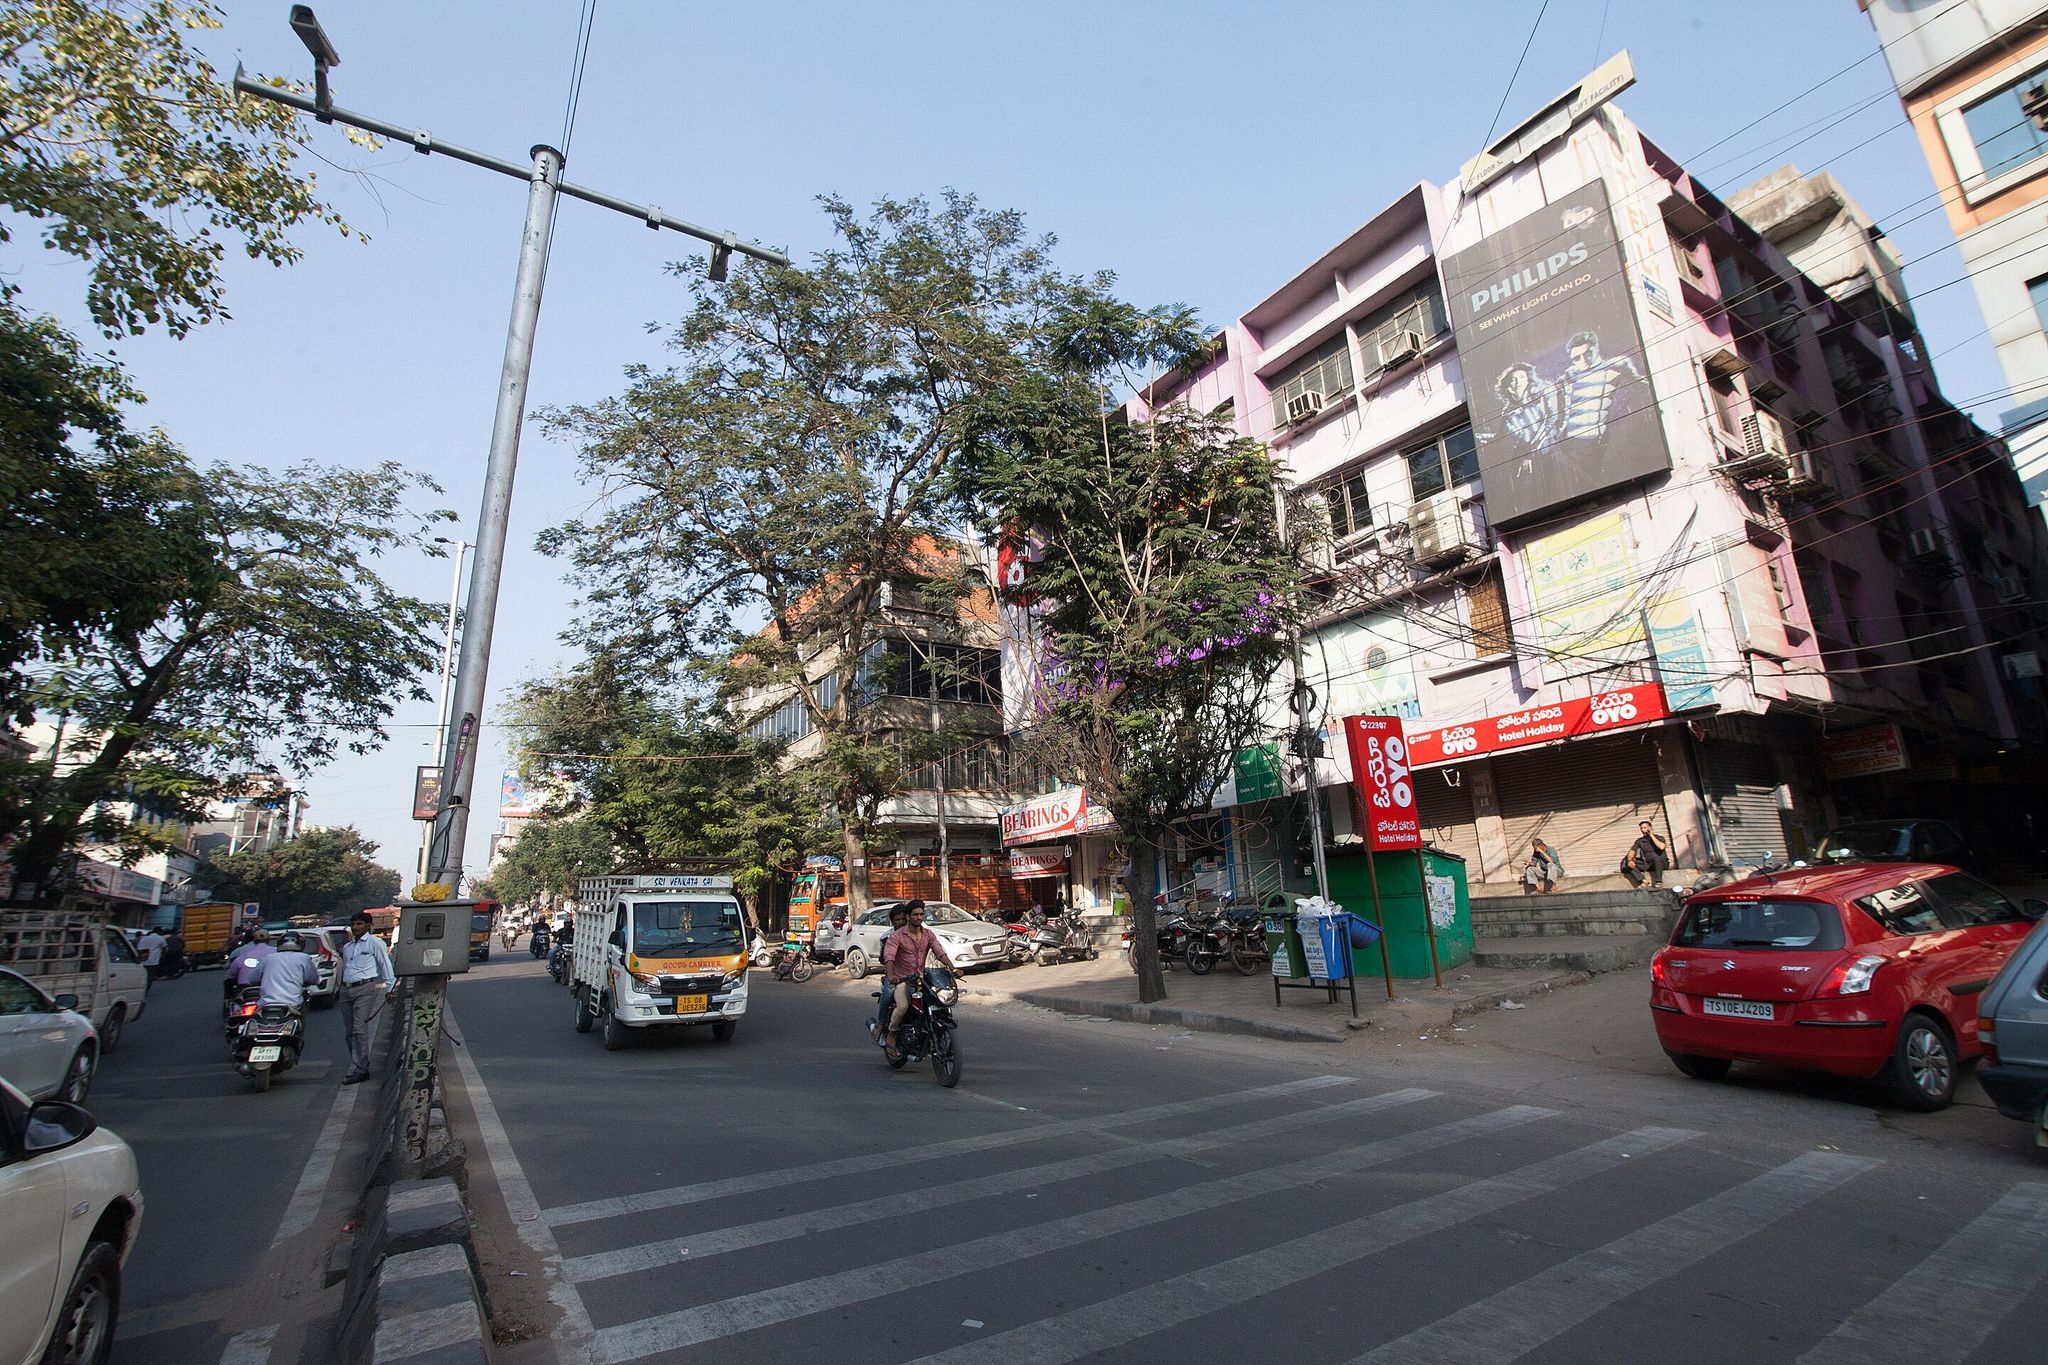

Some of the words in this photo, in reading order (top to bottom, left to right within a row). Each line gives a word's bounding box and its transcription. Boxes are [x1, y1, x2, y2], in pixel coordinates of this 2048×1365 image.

[1471, 241, 1589, 314] PHILIPS
[1478, 318, 1495, 331] SEE
[1492, 306, 1521, 327] WHAT
[1522, 292, 1550, 313] LIGHT
[1550, 283, 1574, 299] CAN
[1574, 273, 1592, 288] DO
[1591, 703, 1638, 725] OYO
[1498, 728, 1526, 743] Hotel
[1526, 722, 1565, 737] Holiday
[1441, 736, 1478, 755] OYO
[1384, 735, 1412, 808] OYO
[1003, 800, 1070, 834] BEARINGS
[1378, 833, 1396, 843] Hotel
[1395, 832, 1418, 843] Holiday
[1011, 853, 1058, 867] BEARINGS
[653, 877, 666, 887] SRI
[669, 877, 699, 886] VENKATA
[702, 878, 713, 886] SAI
[662, 960, 687, 970] GOODS
[688, 960, 721, 969] CARRIER
[1709, 1000, 1772, 1017] TS10EJ4209
